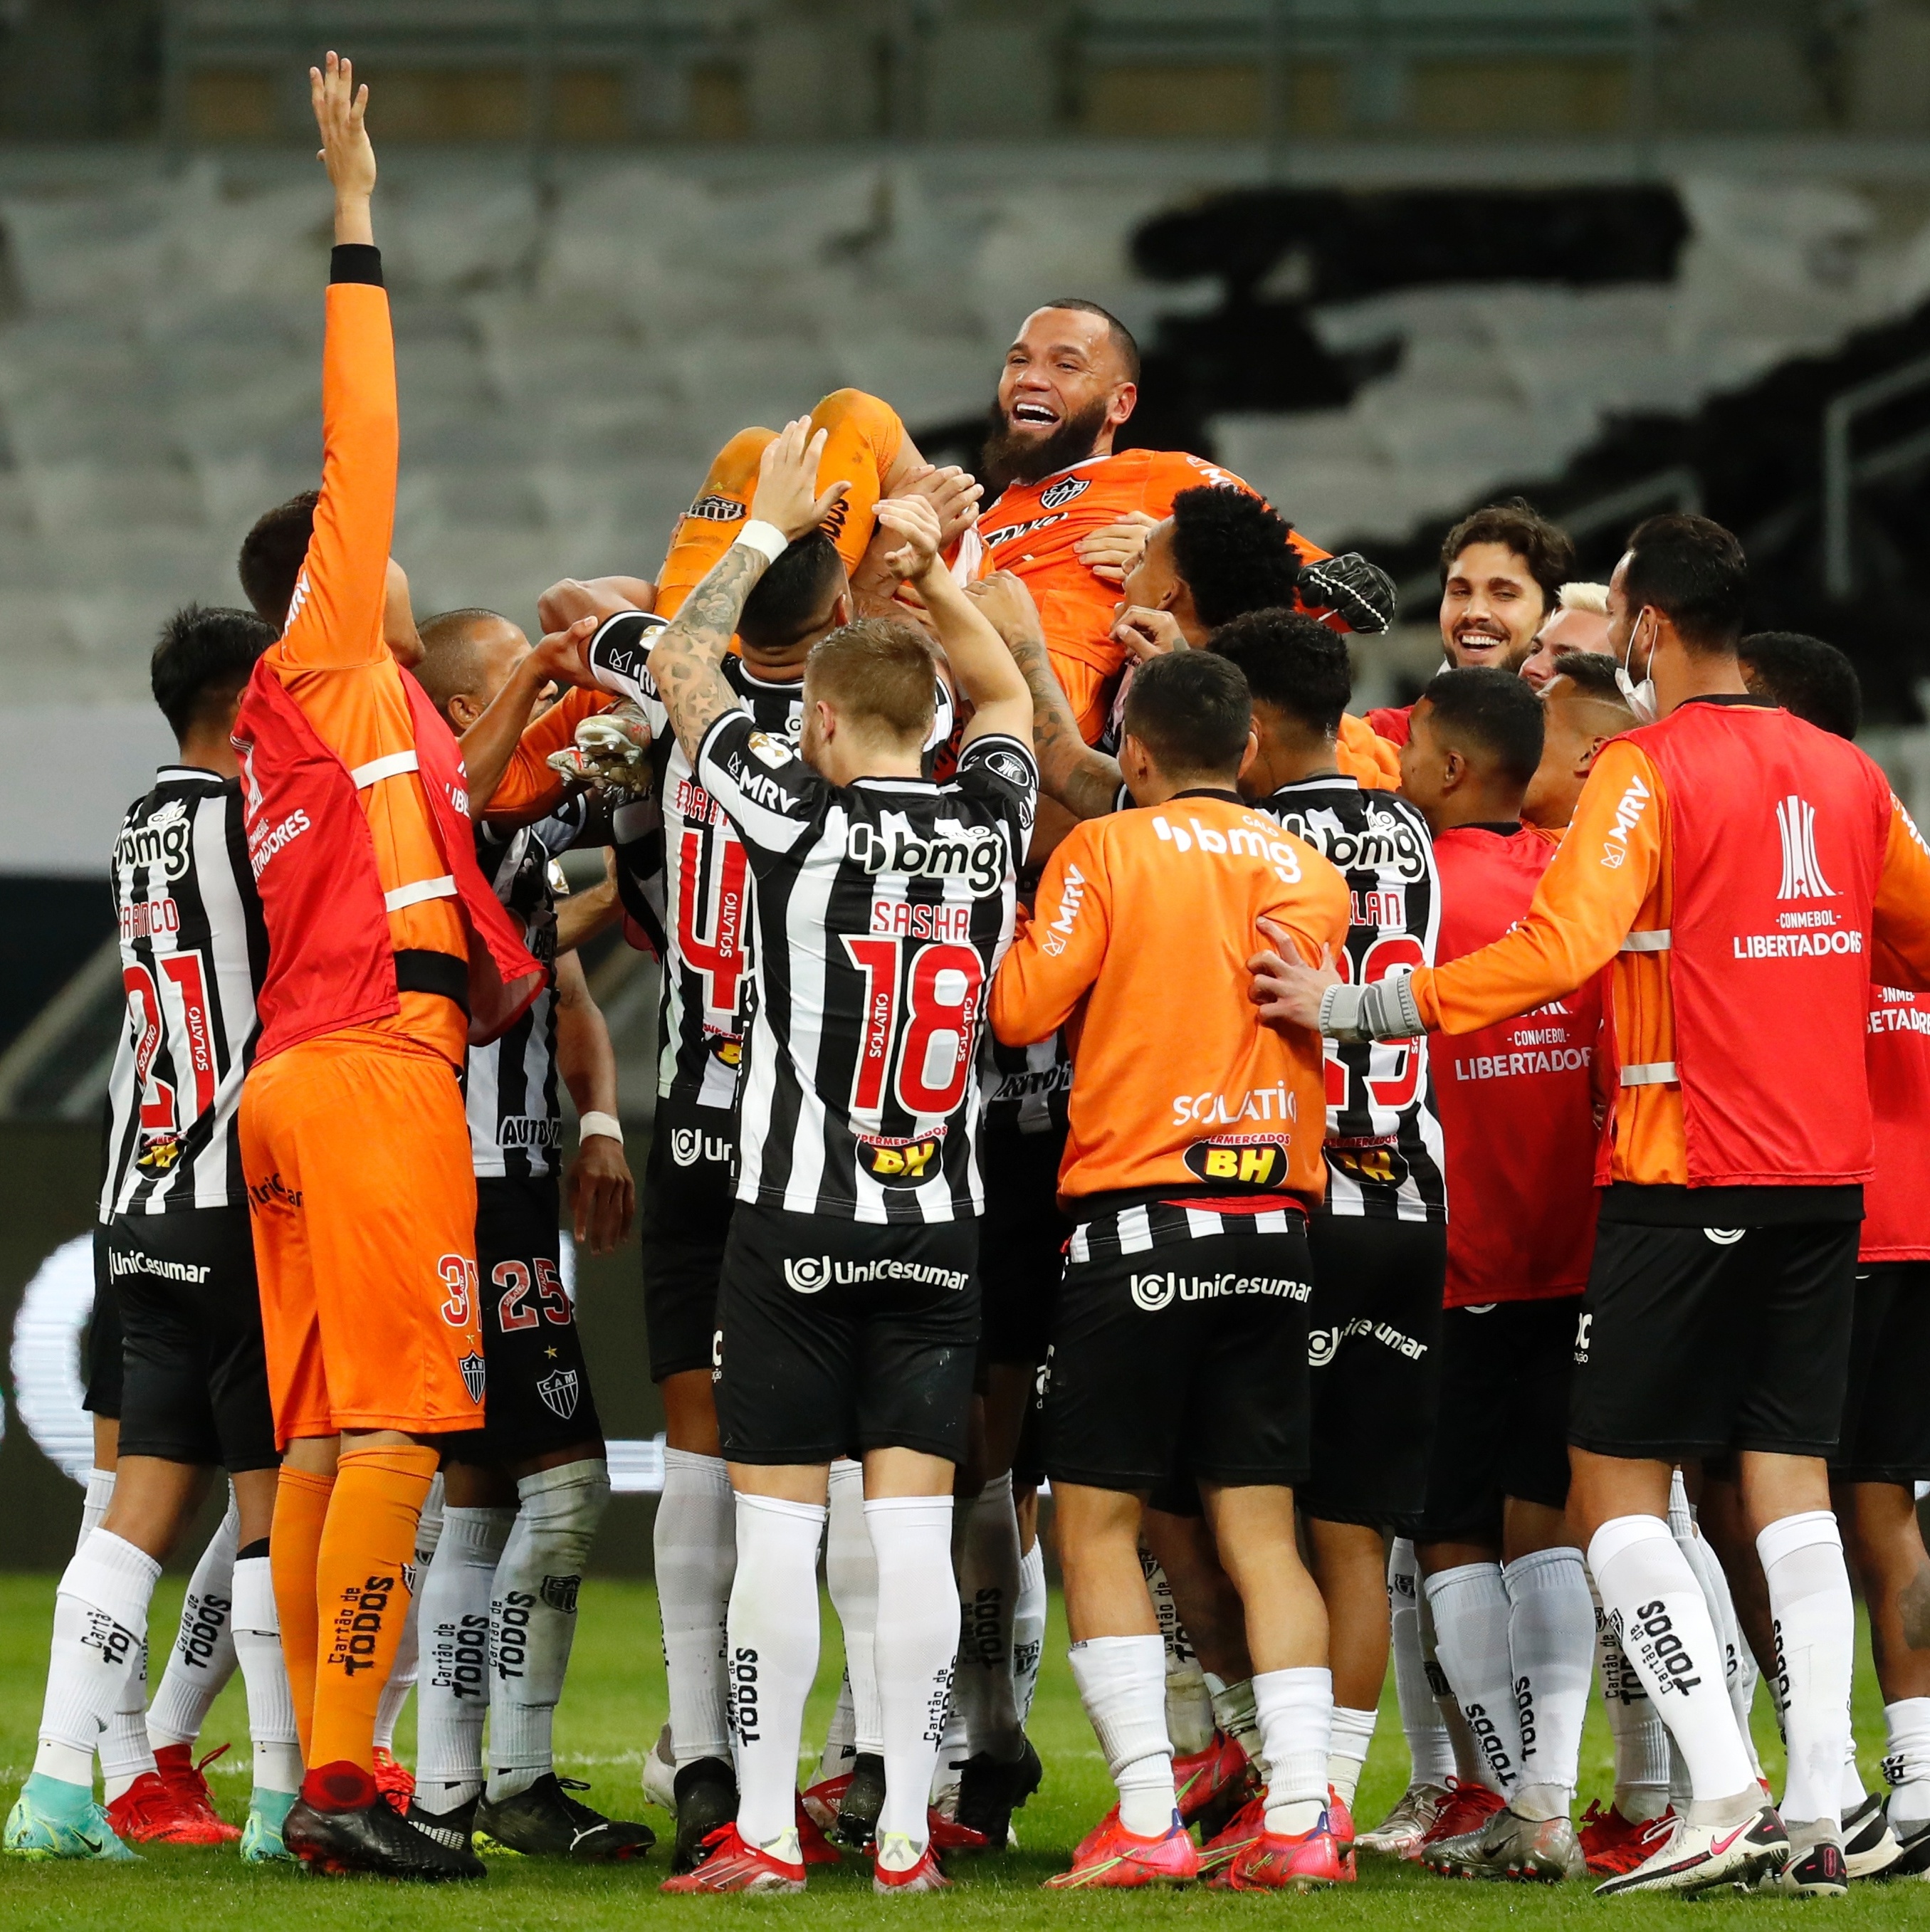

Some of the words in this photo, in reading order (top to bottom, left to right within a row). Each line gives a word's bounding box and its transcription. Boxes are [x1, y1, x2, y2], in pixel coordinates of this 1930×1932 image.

[1049, 483, 1084, 494] CAM
[739, 765, 802, 814] MRV
[1608, 775, 1650, 845] MRV
[1189, 818, 1302, 884] bmg
[1242, 815, 1279, 837] GALO
[1323, 827, 1422, 878] bmg
[891, 830, 1001, 895] bmg
[719, 891, 739, 958] SOLATIO
[873, 901, 969, 941] SASHA
[1051, 863, 1086, 935] MRV
[1349, 891, 1401, 925] LAN
[122, 949, 219, 1133] 21
[137, 1025, 157, 1072] SOLATIO
[189, 1006, 209, 1071] SOLATIO
[839, 934, 987, 1118] 18
[869, 993, 889, 1059] SOLATIO
[958, 997, 974, 1062] SOLATIO
[1204, 1147, 1276, 1184] BH
[112, 1250, 211, 1284] UniCesumar
[834, 1259, 969, 1291] UniCesumar
[1180, 1274, 1312, 1303] UniCesumar
[492, 1257, 572, 1333] 25
[503, 1284, 525, 1307] SOLATIO
[542, 1375, 574, 1391] CAM
[340, 1587, 361, 1602] de
[489, 1600, 503, 1615] de
[176, 1611, 194, 1652] Cartão
[187, 1593, 200, 1610] de
[185, 1595, 231, 1669] TODOS
[327, 1609, 355, 1664] Cartão
[345, 1575, 394, 1676] TODOS
[434, 1623, 456, 1637] de
[498, 1590, 536, 1680] TODOS
[1600, 1634, 1617, 1647] de
[1630, 1624, 1645, 1642] de
[1636, 1600, 1701, 1696] TODOS
[431, 1640, 454, 1688] Cartão
[451, 1614, 490, 1699] TODOS
[1602, 1654, 1620, 1700] Cartão
[1642, 1644, 1674, 1695] Cartão
[736, 1647, 760, 1747] TODOS
[923, 1691, 943, 1741] Cartão
[933, 1669, 948, 1683] de
[1515, 1676, 1537, 1762] TODOS
[1465, 1703, 1517, 1787] TODOS
